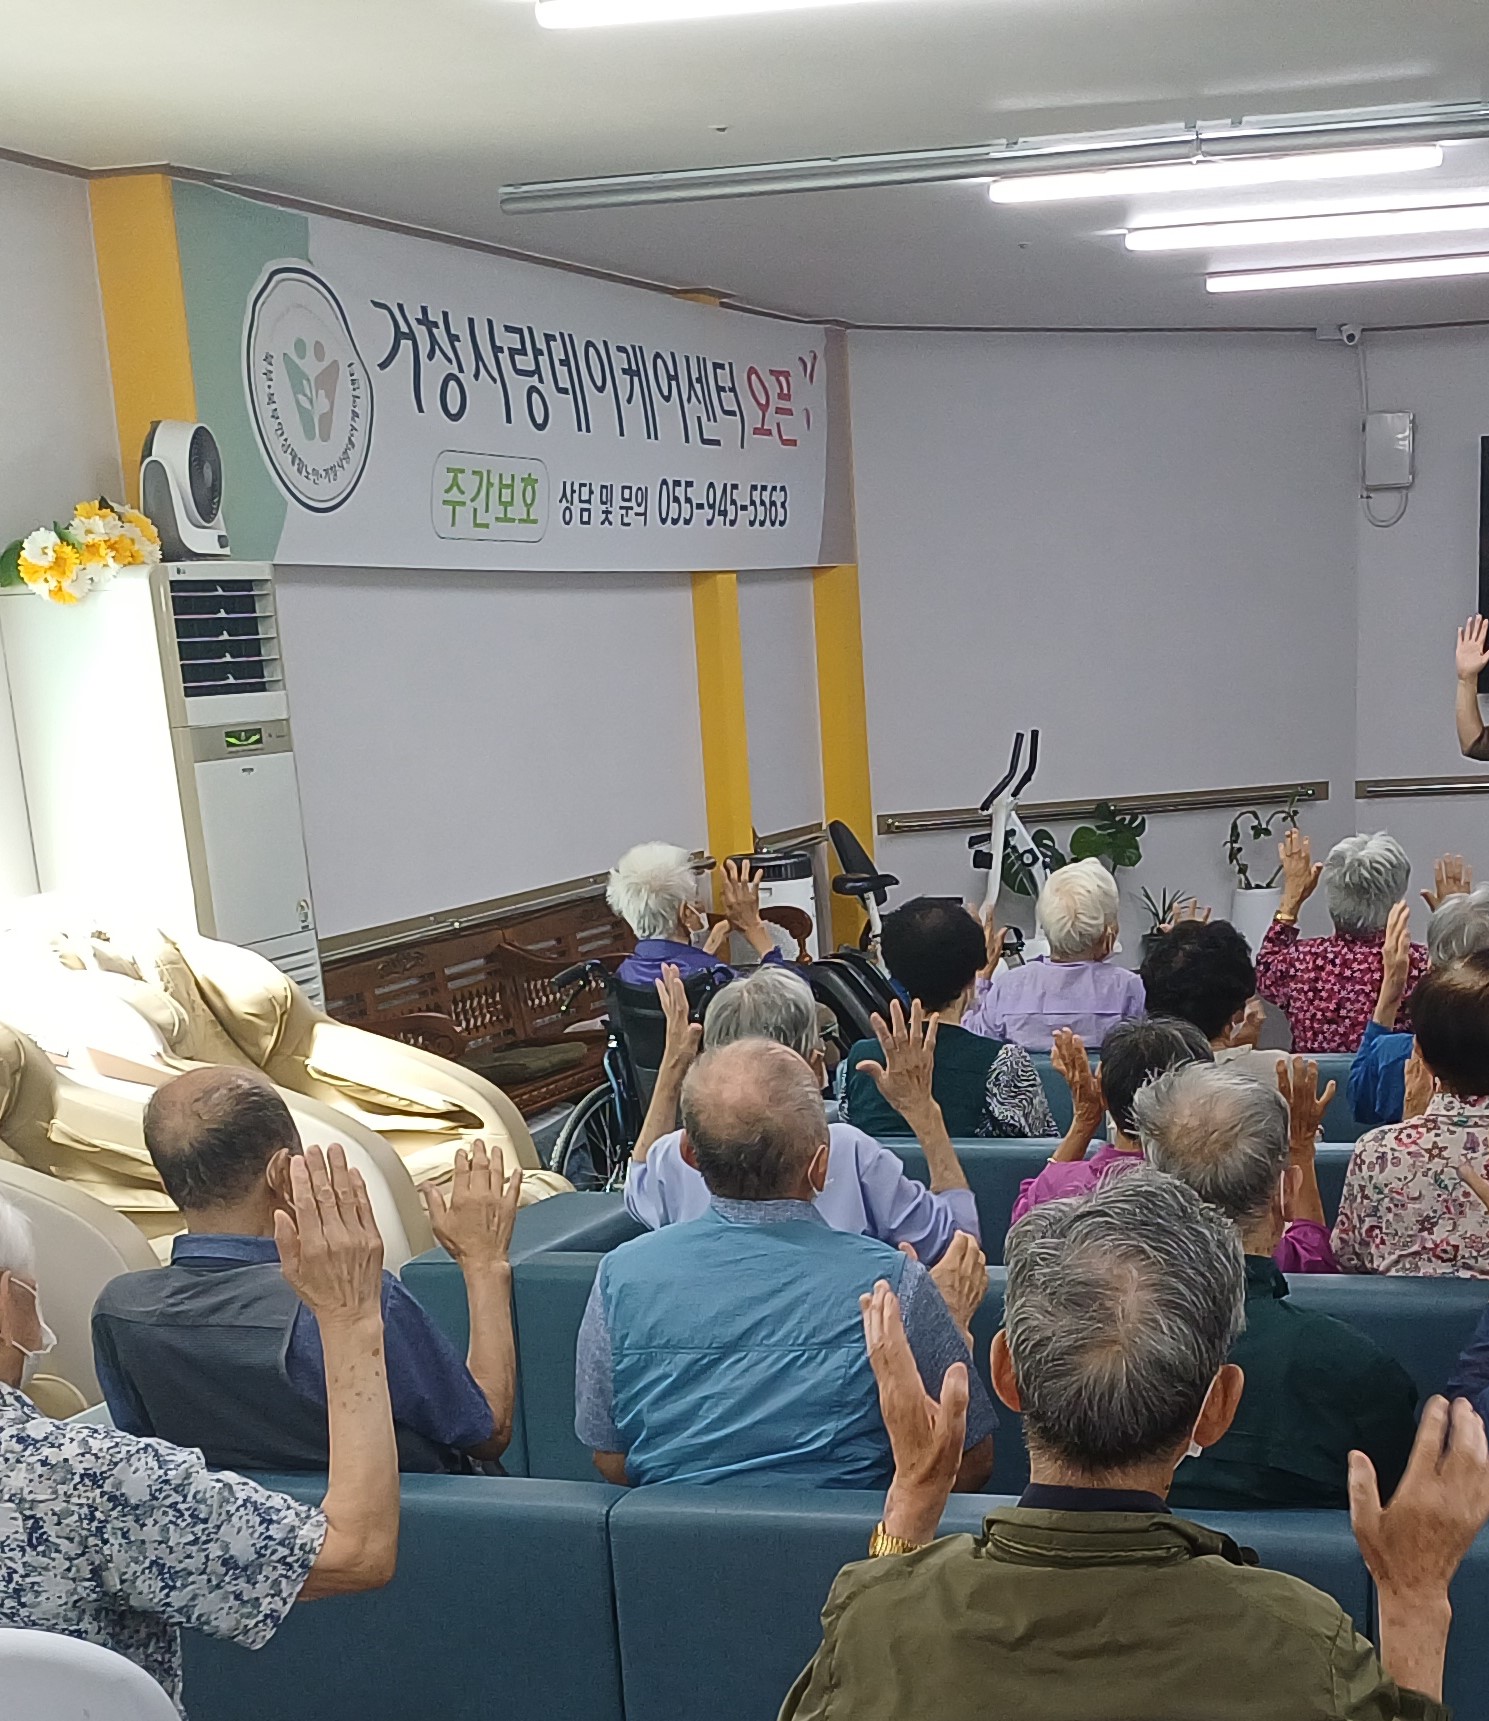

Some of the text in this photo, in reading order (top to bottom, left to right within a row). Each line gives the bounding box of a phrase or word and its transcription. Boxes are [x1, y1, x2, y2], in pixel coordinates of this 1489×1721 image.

[369, 299, 746, 449] 거창사랑데이케어센터
[746, 365, 798, 447] 오픈
[442, 466, 539, 530] 주간보호
[558, 478, 789, 529] 상담 및 문의 055-945-5563
